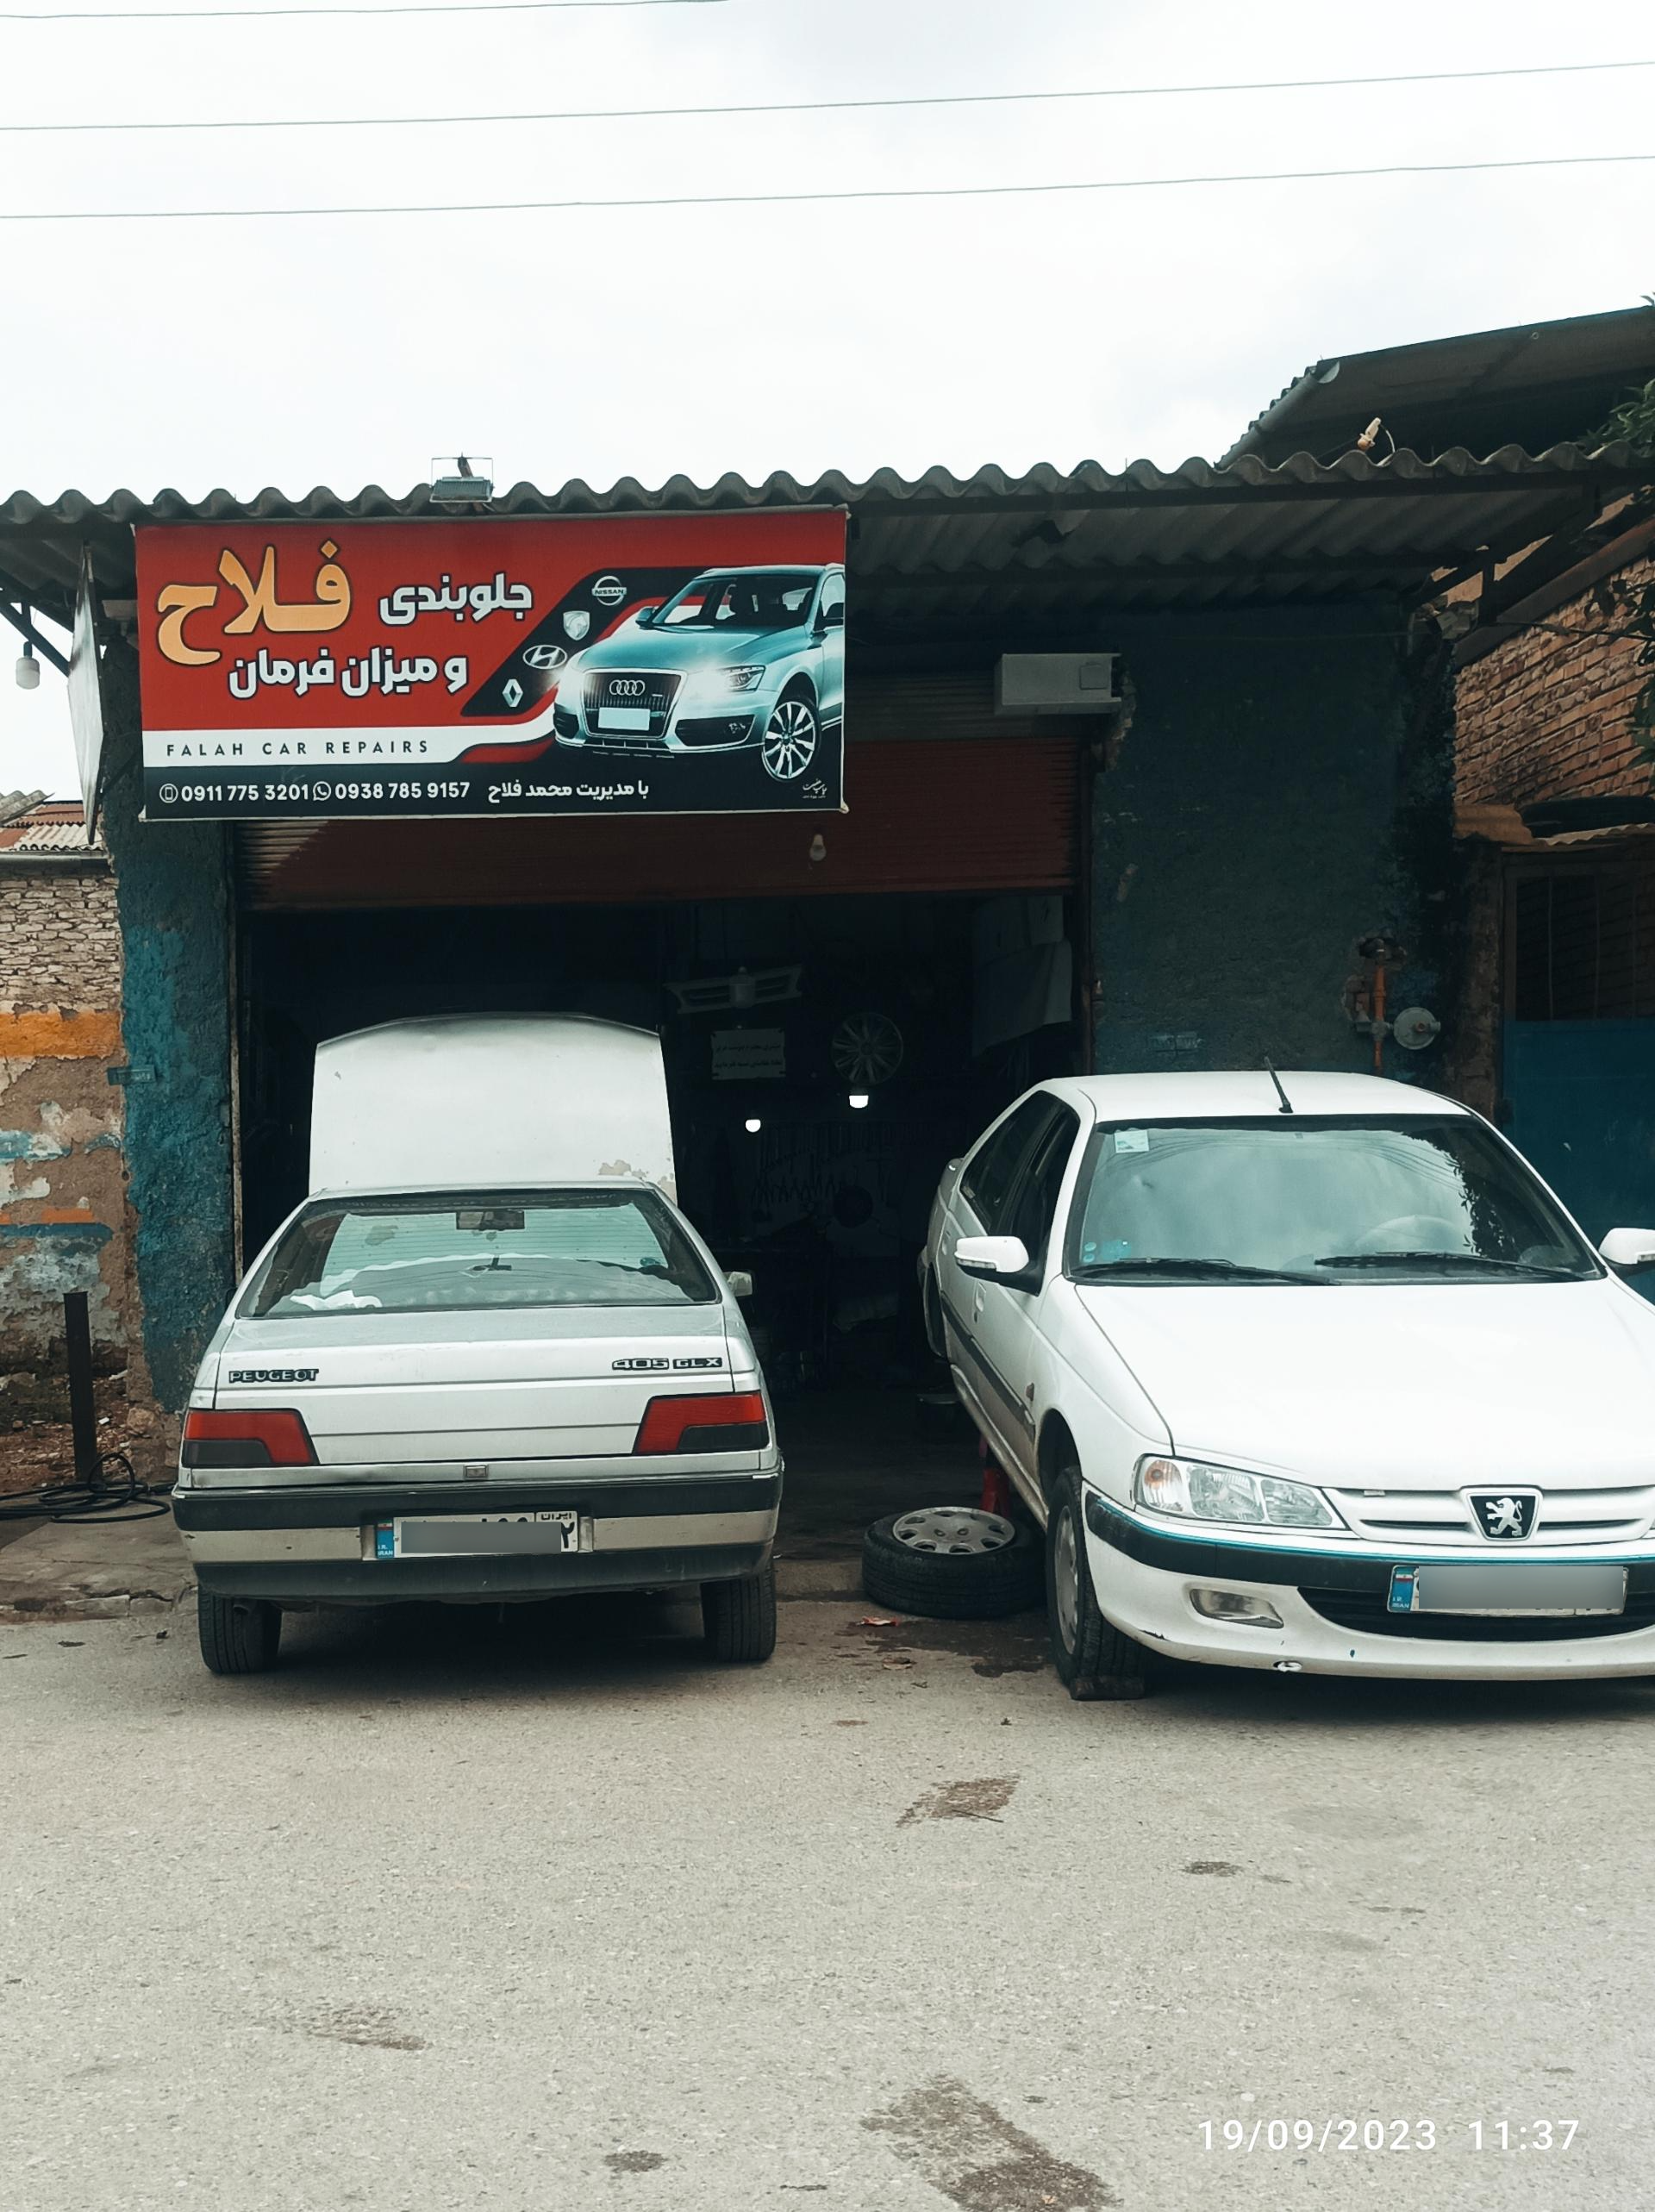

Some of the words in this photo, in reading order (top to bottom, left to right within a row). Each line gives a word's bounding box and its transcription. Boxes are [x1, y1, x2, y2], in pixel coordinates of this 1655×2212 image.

[157, 540, 352, 665] فلاح
[379, 573, 533, 625] جلوبندی
[228, 648, 334, 698] فرمان
[341, 647, 439, 697] میزان
[443, 656, 468, 693] و
[166, 743, 243, 756] FALAH
[262, 741, 307, 755] CAR
[326, 740, 428, 753] REPAIRS
[181, 784, 222, 802] 0911
[227, 784, 259, 802] 775
[265, 784, 309, 801] 3201
[334, 783, 384, 800] 0938
[388, 782, 422, 799] 785
[427, 781, 471, 798] 9157
[488, 778, 522, 803] فلاح
[525, 784, 572, 797] محمد
[576, 784, 634, 801] مدیریت
[637, 779, 650, 799] با
[611, 1358, 670, 1371] 405
[672, 1357, 723, 1370] GLX
[228, 1368, 320, 1384] PEUGEOT
[540, 1512, 572, 1521] ایران
